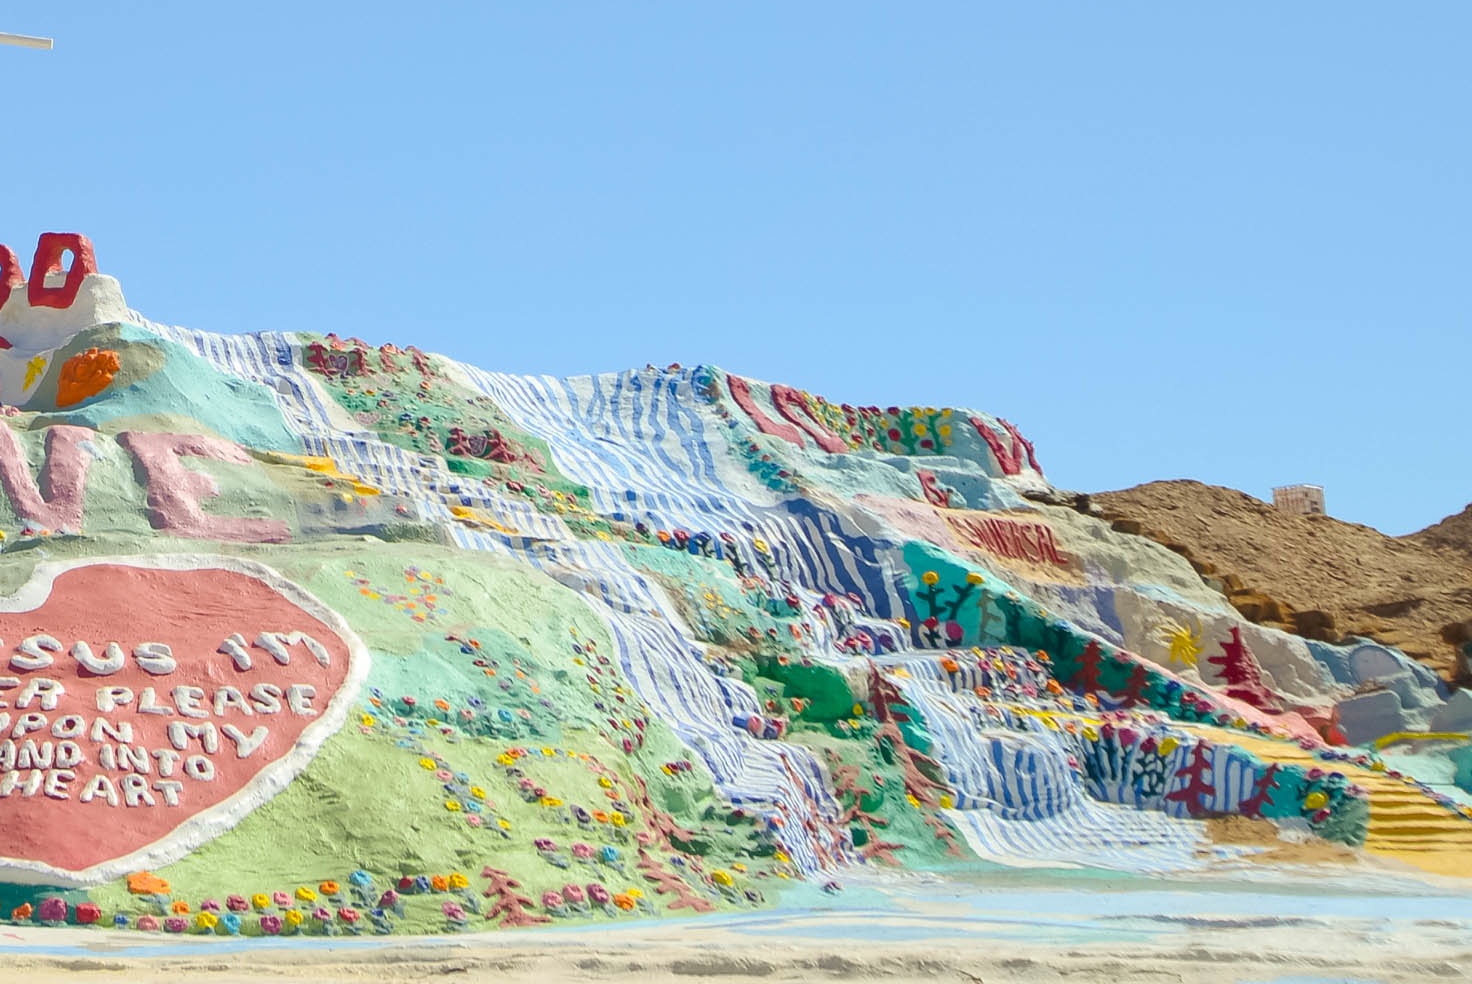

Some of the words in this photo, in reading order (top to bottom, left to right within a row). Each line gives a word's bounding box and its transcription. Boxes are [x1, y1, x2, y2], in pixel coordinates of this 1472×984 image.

[216, 630, 331, 671] I'M
[94, 682, 319, 719] PLEASE
[167, 720, 270, 759] MY
[98, 742, 216, 782] INTO
